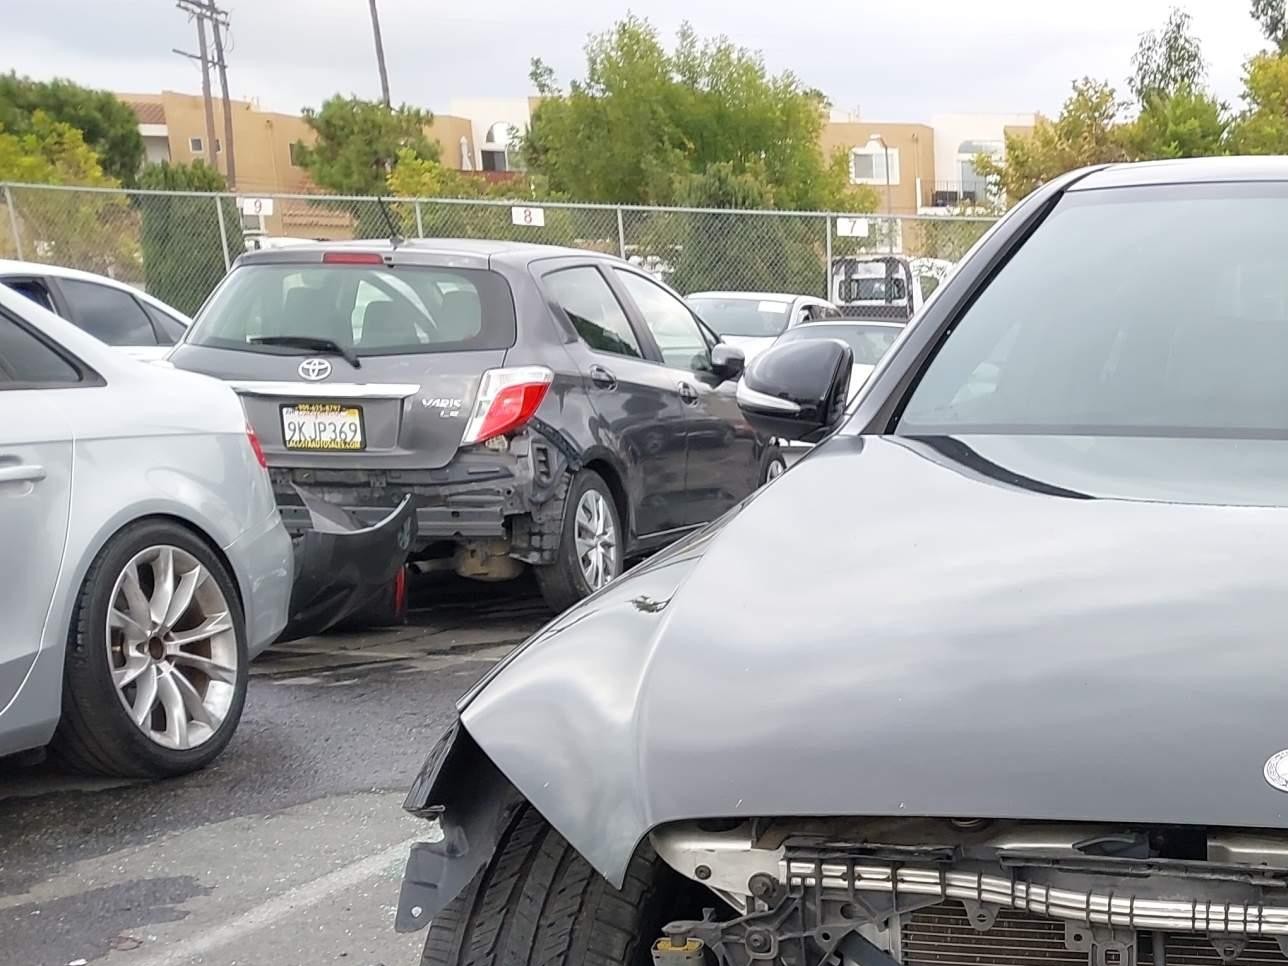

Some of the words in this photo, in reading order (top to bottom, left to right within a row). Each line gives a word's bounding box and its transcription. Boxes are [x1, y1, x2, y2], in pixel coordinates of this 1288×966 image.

[254, 199, 262, 214] 9
[524, 208, 533, 224] 8
[848, 219, 857, 235] 7
[287, 421, 358, 442] 9KJP369
